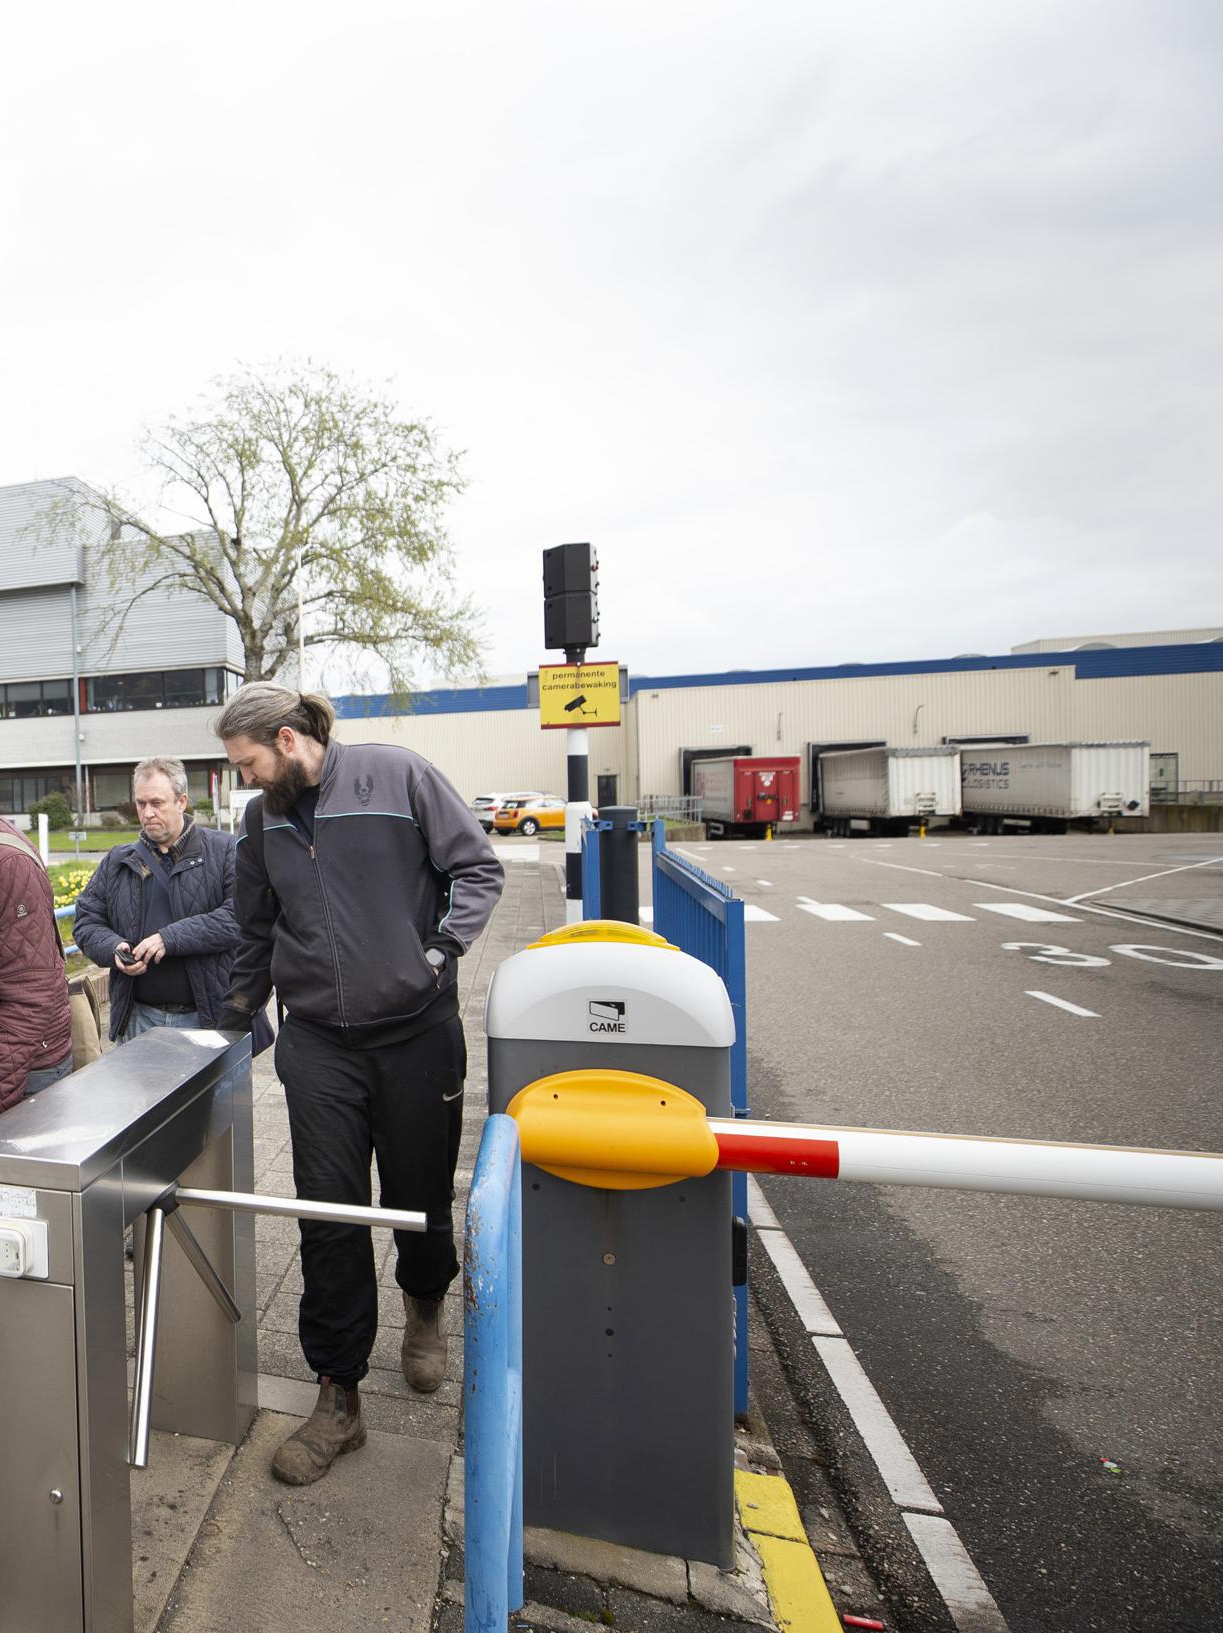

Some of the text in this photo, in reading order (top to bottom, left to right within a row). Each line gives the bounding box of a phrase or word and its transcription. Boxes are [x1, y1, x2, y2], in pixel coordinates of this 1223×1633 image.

[552, 670, 606, 680] permanente
[542, 681, 617, 691] camerabewaking
[969, 762, 1009, 776] RHENUS
[1001, 942, 1223, 970] 30
[589, 1022, 625, 1032] CAME
